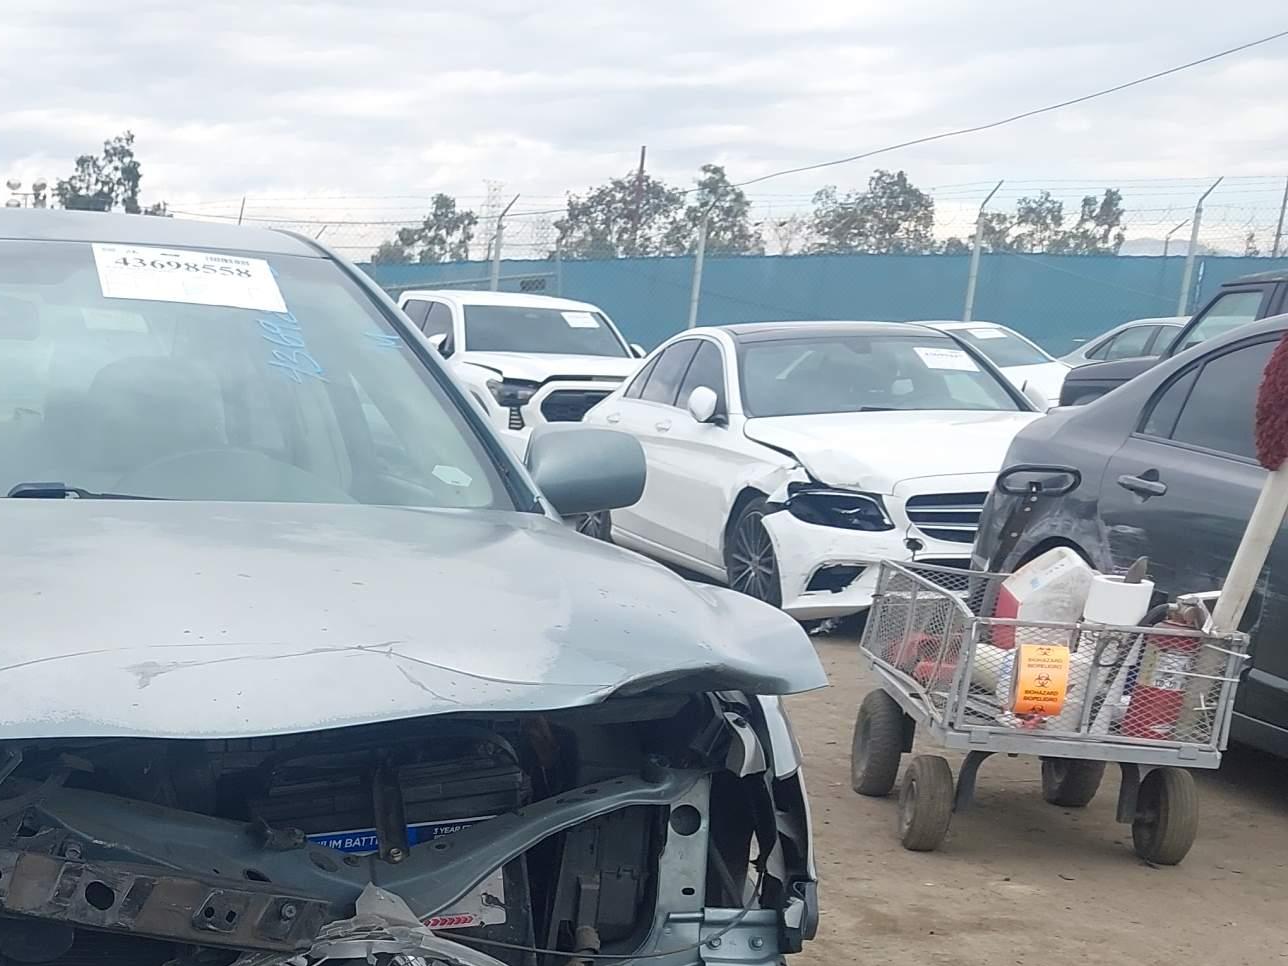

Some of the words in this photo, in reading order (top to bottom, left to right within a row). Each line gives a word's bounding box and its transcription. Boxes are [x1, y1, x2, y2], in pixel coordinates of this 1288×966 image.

[114, 256, 253, 278] 43698558
[440, 825, 461, 834] YEAR
[344, 835, 379, 848] BATT
